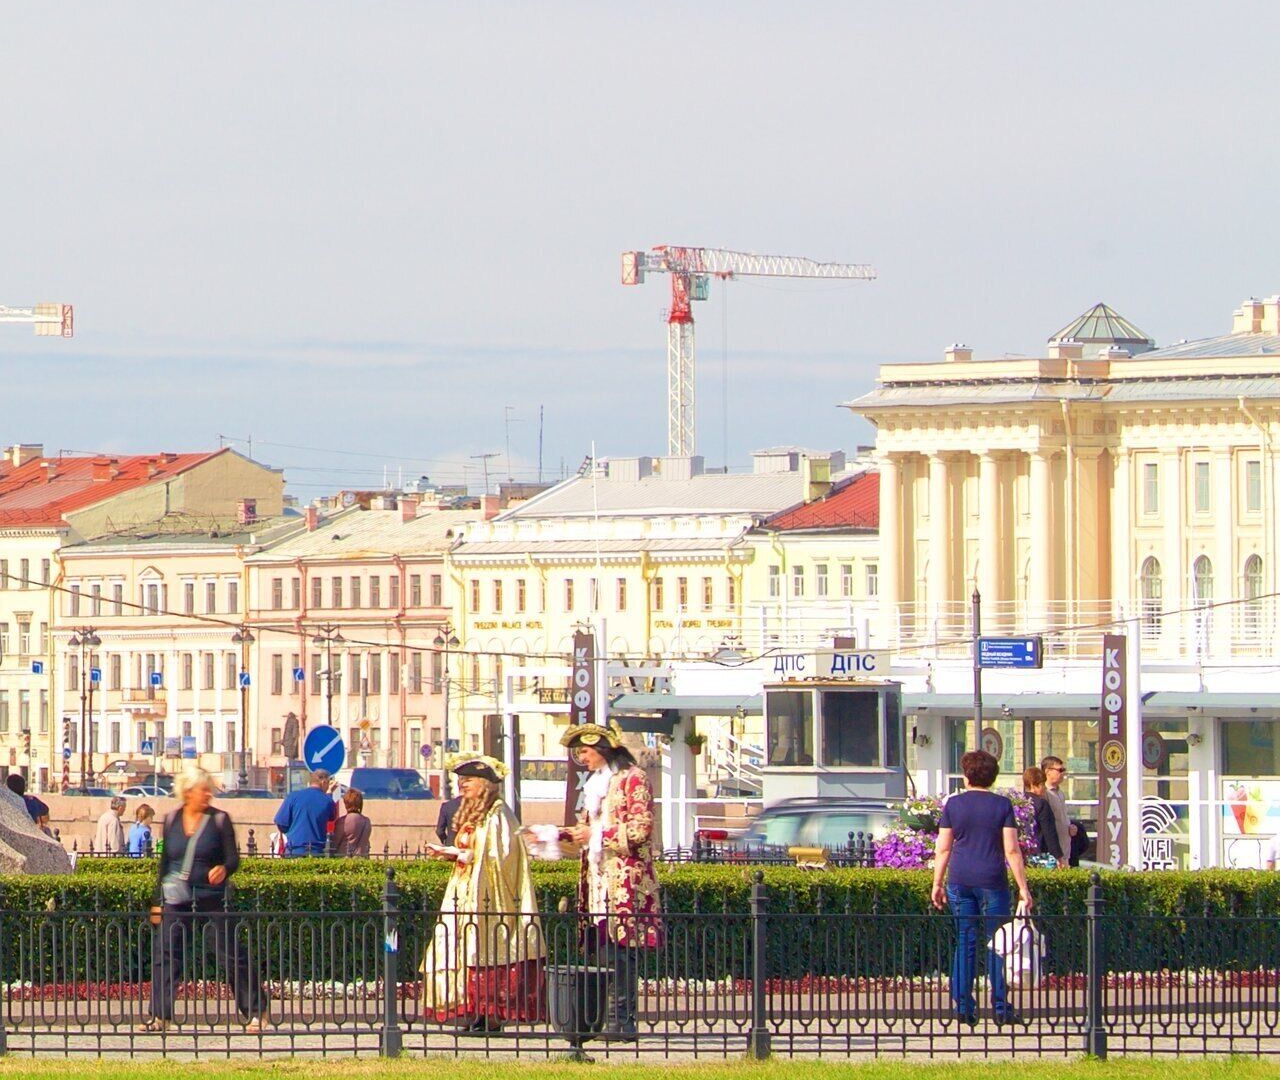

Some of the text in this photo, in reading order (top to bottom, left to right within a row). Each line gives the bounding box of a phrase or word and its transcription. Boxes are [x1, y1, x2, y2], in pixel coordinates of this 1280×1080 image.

[773, 655, 805, 675] ДПС
[830, 653, 876, 674] ДПС
[1104, 648, 1123, 735] КОФЕ
[1106, 777, 1123, 866] ХАУЗ
